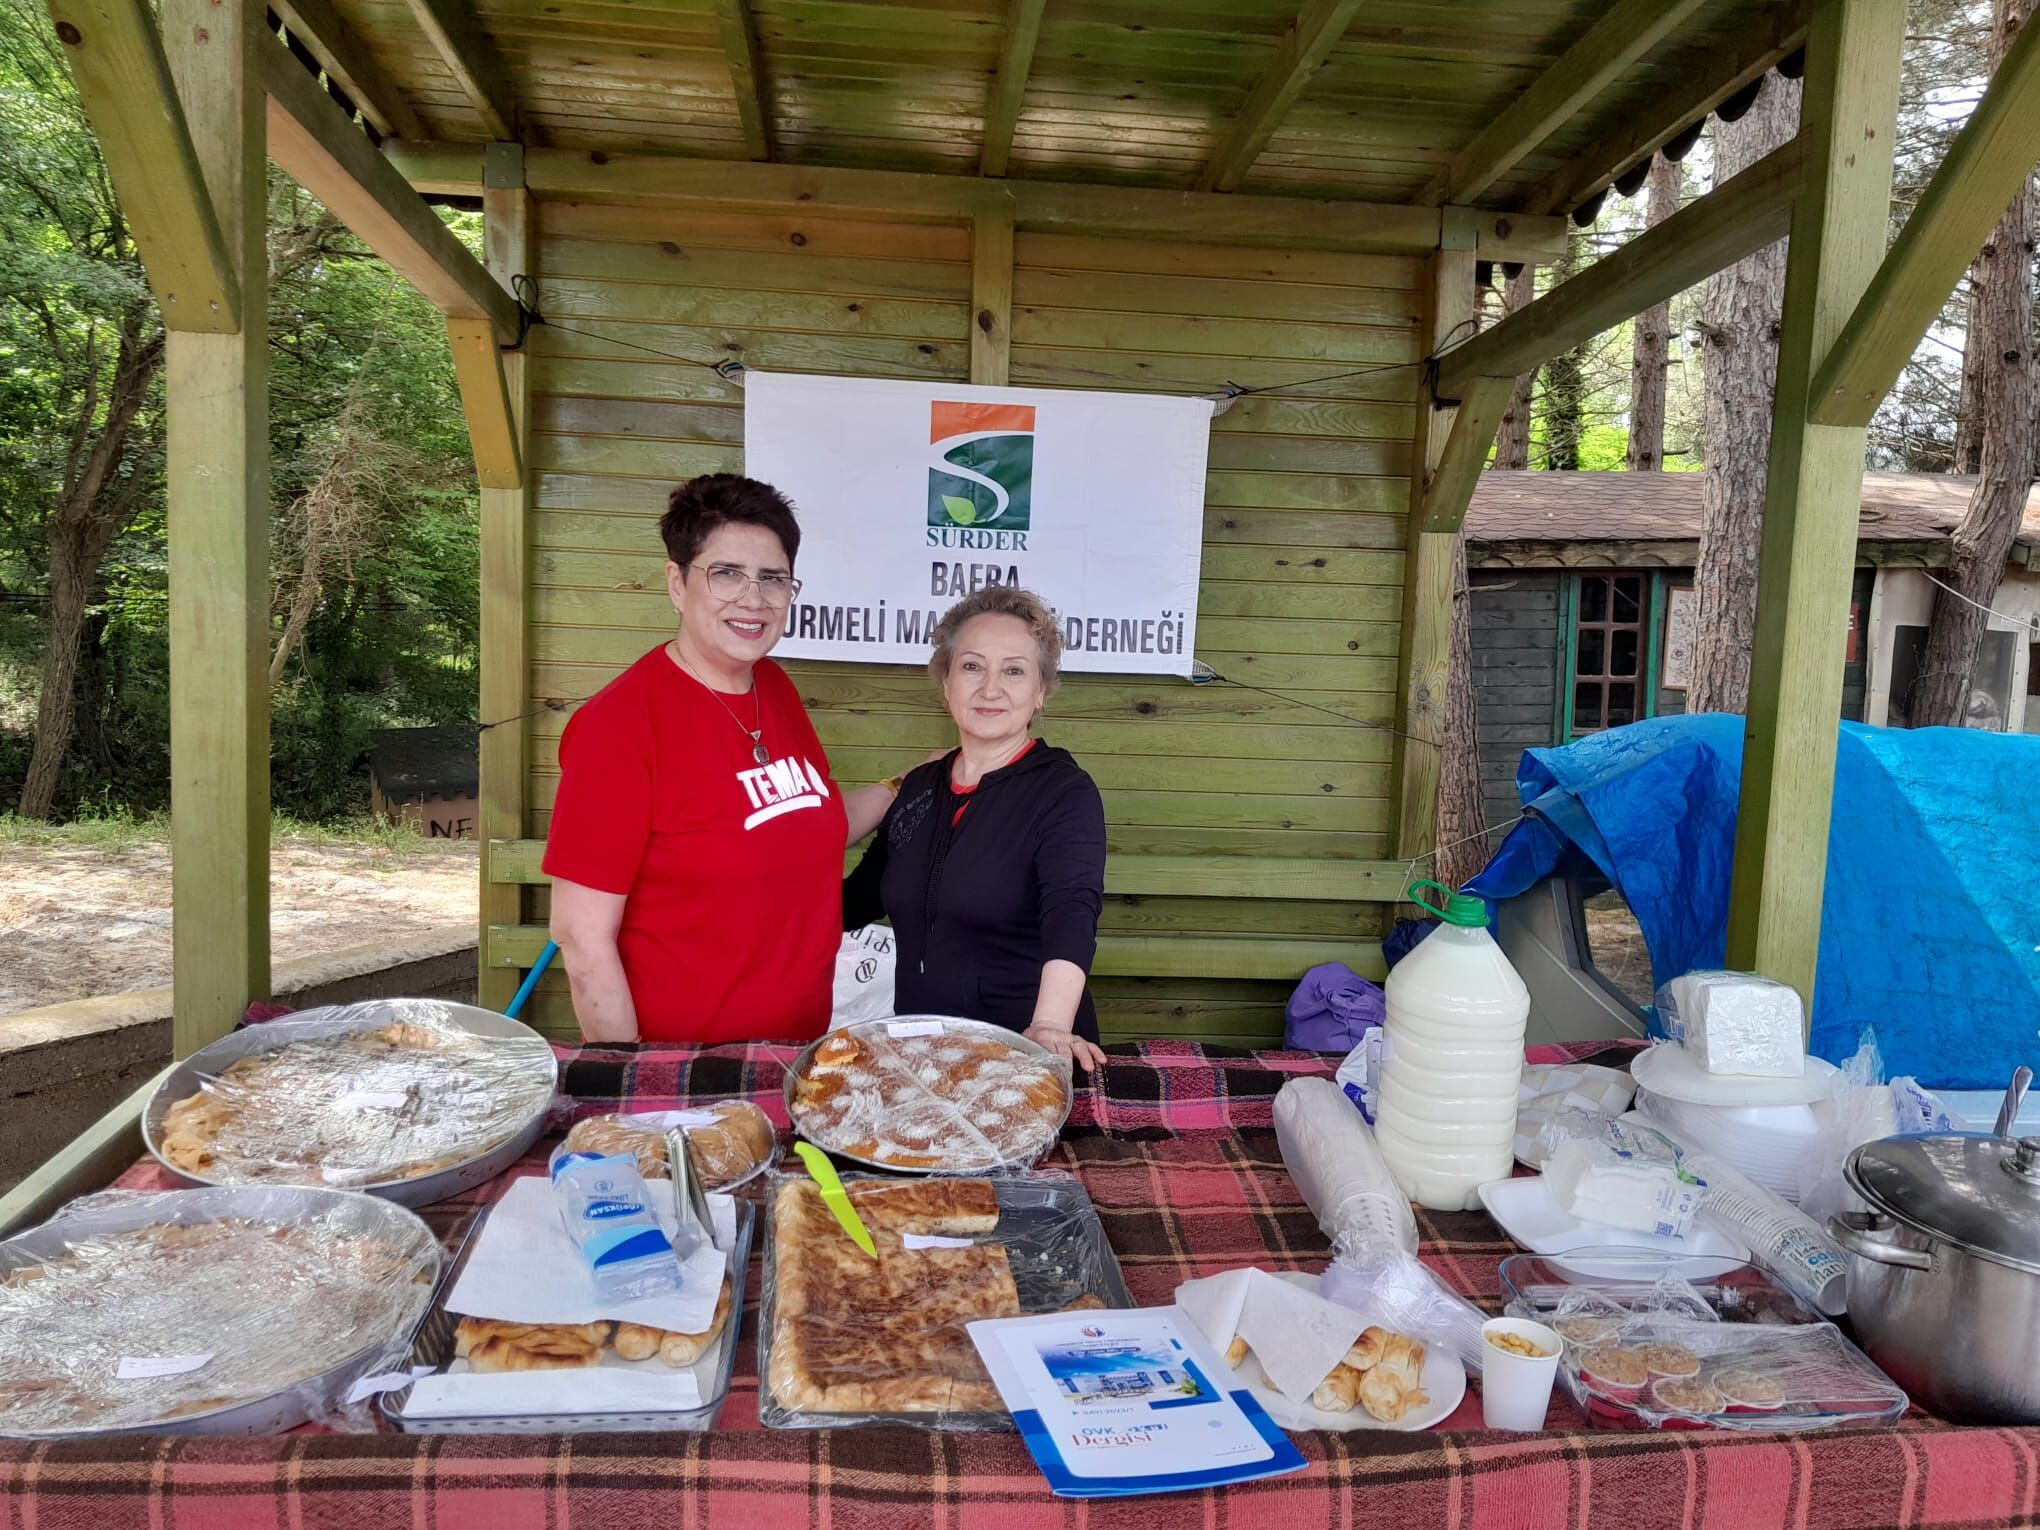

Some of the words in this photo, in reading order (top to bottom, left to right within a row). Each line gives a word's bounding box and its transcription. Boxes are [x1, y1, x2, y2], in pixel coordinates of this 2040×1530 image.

[926, 522, 1028, 552] SÜRDER
[1065, 610, 1185, 655] DERNEĞİ
[736, 756, 812, 809] TEMA
